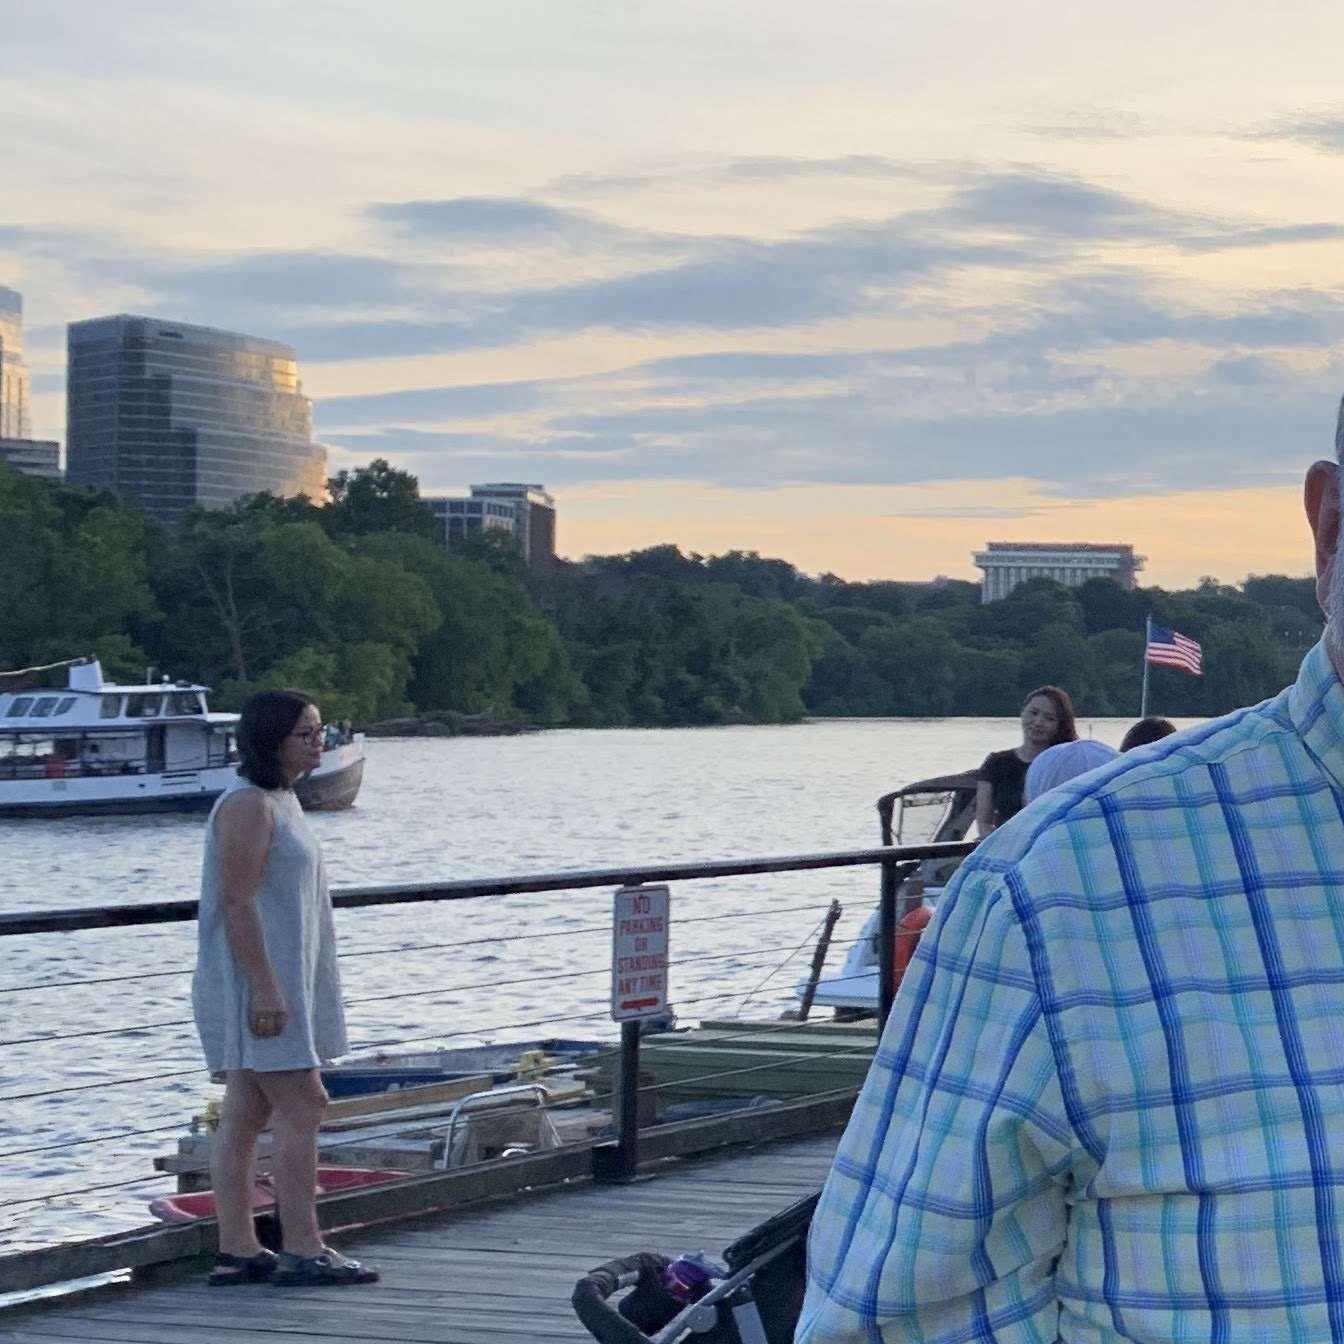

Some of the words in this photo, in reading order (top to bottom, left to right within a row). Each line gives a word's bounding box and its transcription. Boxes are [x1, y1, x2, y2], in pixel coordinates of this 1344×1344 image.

[632, 896, 650, 914] NO
[620, 917, 663, 935] PARKING
[635, 937, 648, 952] OR
[618, 953, 664, 973] STANDING
